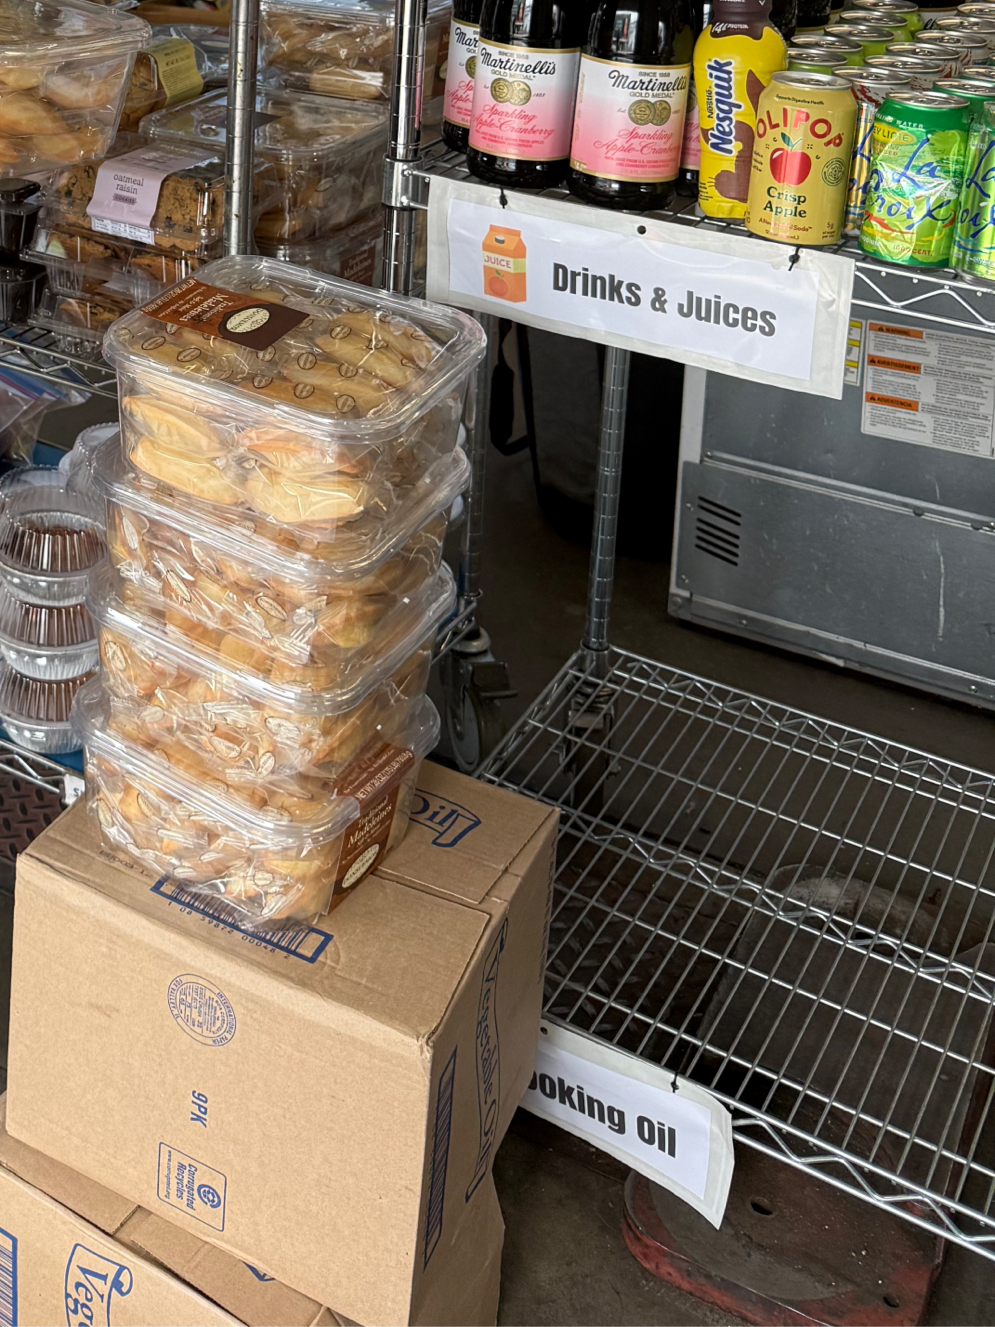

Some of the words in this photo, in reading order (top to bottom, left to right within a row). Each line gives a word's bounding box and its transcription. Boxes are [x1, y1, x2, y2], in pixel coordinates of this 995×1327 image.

[491, 69, 507, 77] GOLD
[482, 104, 538, 125] Sparkling
[707, 58, 743, 156] Nesquik
[472, 114, 555, 140] Apple-Cranberry
[618, 126, 673, 145] Sparkling
[756, 107, 844, 149] OLIPOP
[882, 128, 909, 142] LIME
[896, 119, 924, 129] WATER
[113, 173, 145, 187] oatmeal
[115, 182, 138, 195] raisin
[766, 185, 807, 204] Crisp
[763, 200, 807, 218] Apple
[483, 254, 512, 270] JUICE
[178, 292, 230, 323] Madeleines
[552, 261, 642, 308] Drinks
[650, 286, 668, 314] &
[677, 289, 776, 337] Juices
[876, 359, 920, 372] AVERTISSEMENT
[876, 396, 912, 408] ADVERTENCIA
[347, 803, 392, 847] Madeleines
[358, 795, 389, 827] Traditional
[179, 907, 193, 916] 08
[200, 915, 235, 935] 59872
[241, 934, 277, 954] 00048
[476, 949, 500, 1106] Vegetable
[189, 1089, 208, 1129] 9PK
[528, 1071, 626, 1136] oking
[636, 1114, 677, 1159] Oil
[477, 1099, 498, 1172] Oil
[175, 1161, 187, 1201] Recycles
[186, 1163, 198, 1211] Corrugated
